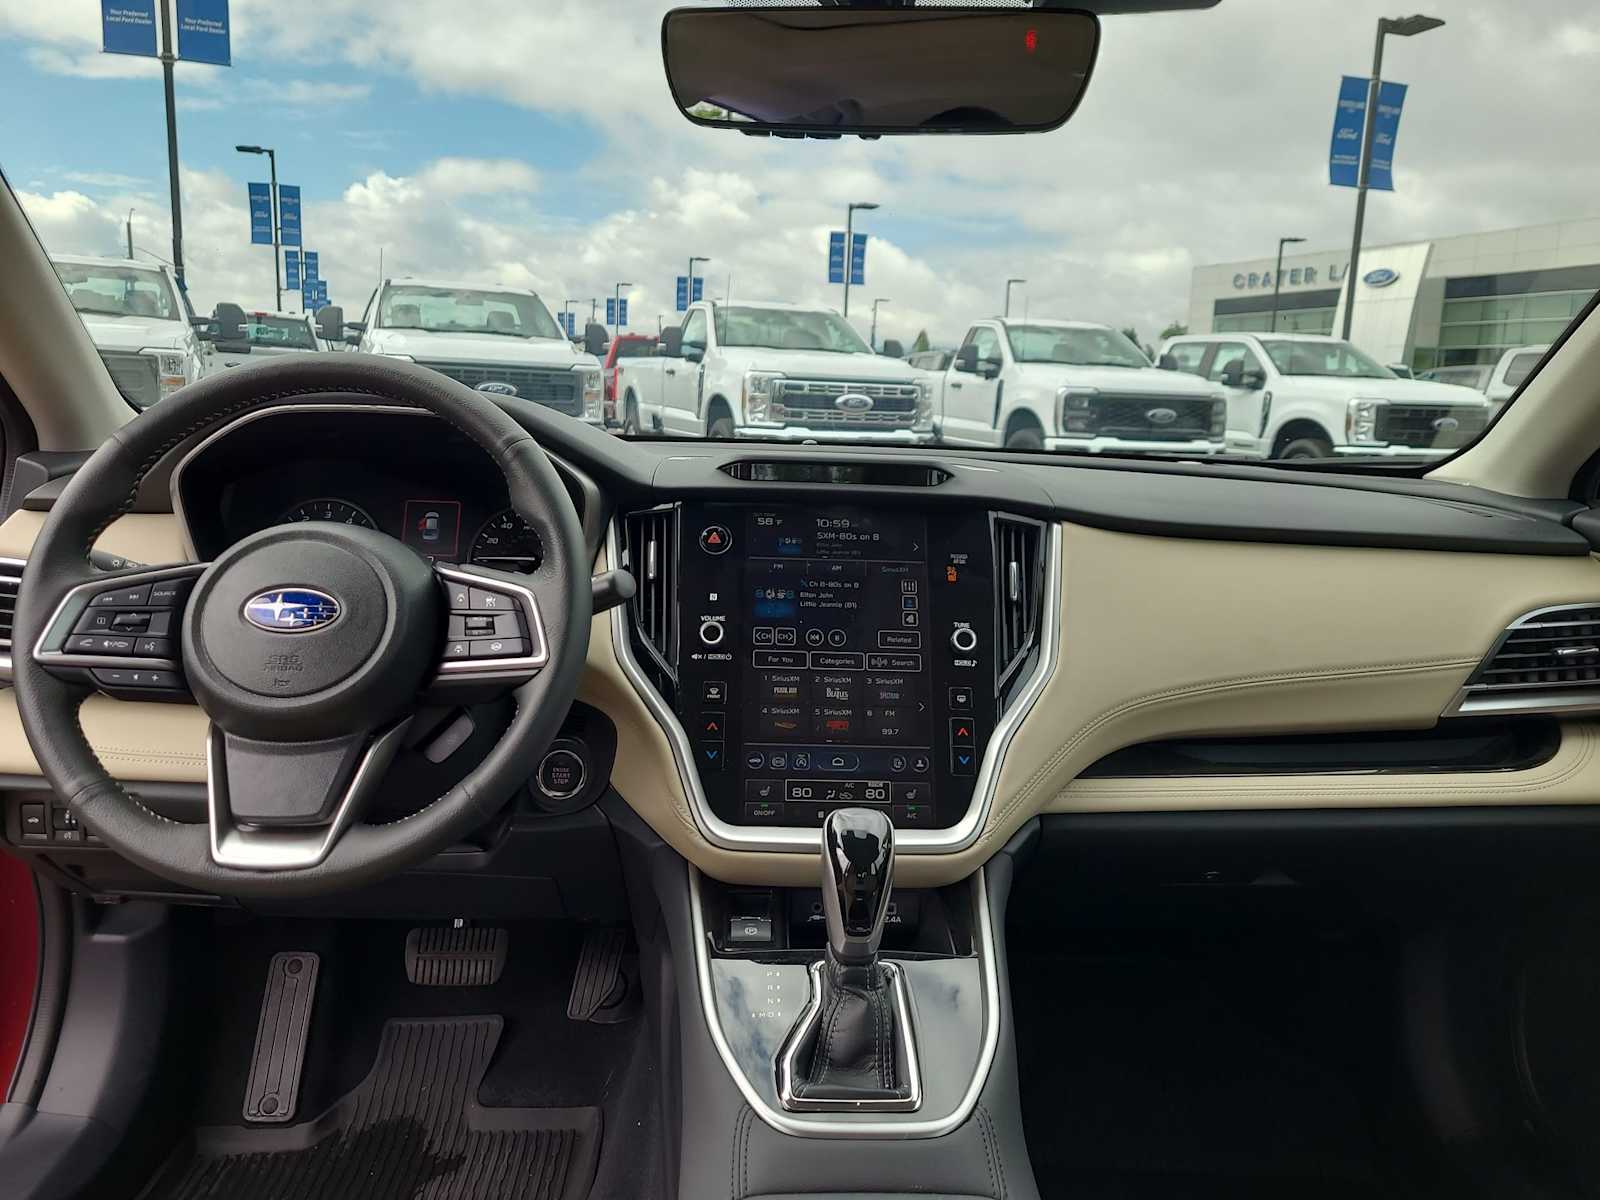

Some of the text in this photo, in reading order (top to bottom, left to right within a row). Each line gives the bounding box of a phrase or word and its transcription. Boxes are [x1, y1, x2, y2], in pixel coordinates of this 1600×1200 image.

[123, 9, 149, 17] Preferred
[197, 19, 223, 27] Preferred
[1232, 266, 1318, 289] CRATER
[757, 517, 774, 526] 58
[816, 518, 850, 528] 10:59
[817, 532, 857, 541] SXM-80s
[872, 533, 880, 541] 8
[773, 562, 784, 570] FM
[831, 564, 843, 572] AM
[799, 591, 816, 599] Elton
[818, 591, 834, 599] John
[953, 621, 970, 629] TUNE
[887, 635, 912, 644] Related
[768, 655, 794, 664] For You
[820, 657, 855, 666] Categories
[891, 659, 914, 667] Search
[772, 675, 800, 683] SiriusXM
[824, 676, 852, 684] SiriusXM
[875, 678, 904, 686] SiriusXM
[824, 708, 852, 716] SiriusXM
[792, 787, 812, 798] 80
[865, 788, 885, 800] 80
